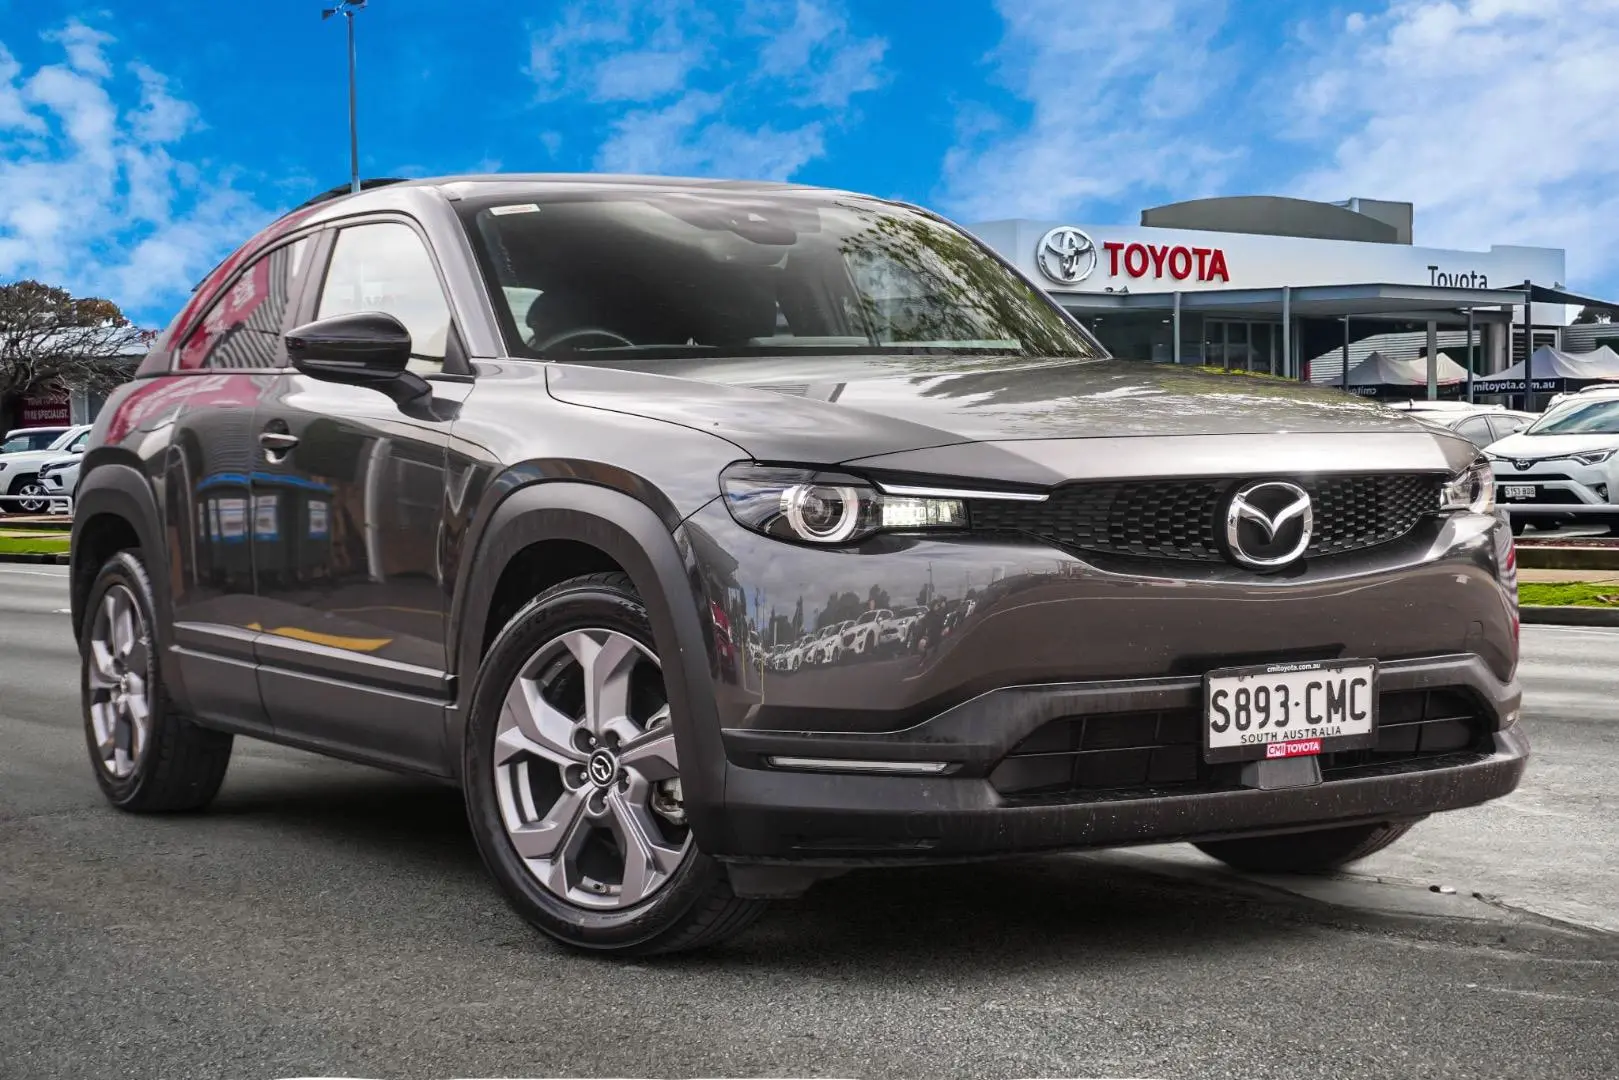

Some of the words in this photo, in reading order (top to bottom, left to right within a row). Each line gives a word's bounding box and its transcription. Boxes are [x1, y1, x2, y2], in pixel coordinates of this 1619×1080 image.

[1103, 241, 1230, 282] TOYOTA
[1427, 265, 1488, 288] Toyota
[1473, 381, 1555, 392] mitoyota.cm.au
[1266, 663, 1321, 673] cmitoyota.com.au
[1241, 731, 1278, 744] SOUTH
[1283, 726, 1342, 740] AUSTRALIA
[1287, 742, 1320, 754] TOYOTA
